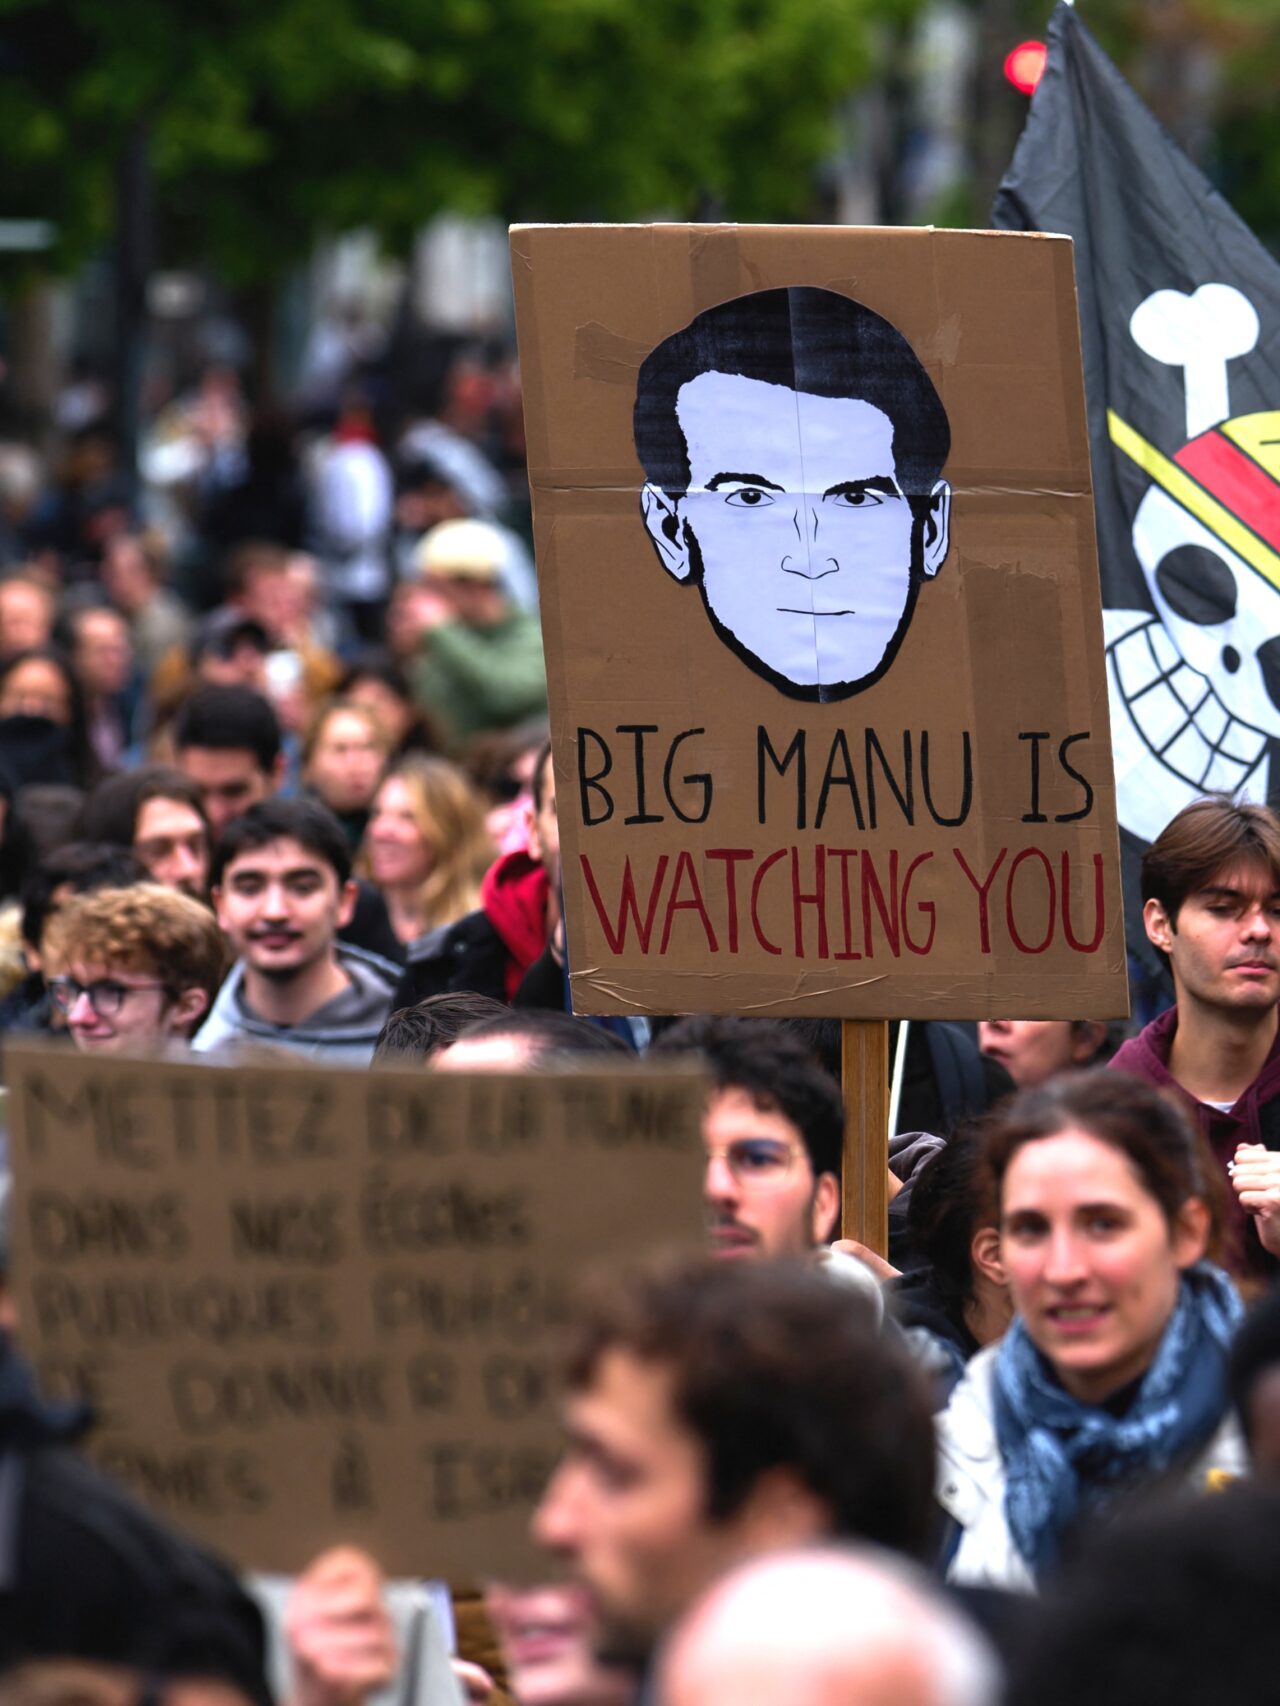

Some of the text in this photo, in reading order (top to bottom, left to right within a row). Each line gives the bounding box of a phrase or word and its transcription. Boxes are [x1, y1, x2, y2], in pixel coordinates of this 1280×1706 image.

[577, 724, 1095, 831] BIG MANU IS
[579, 843, 1105, 961] WATCHING YOU
